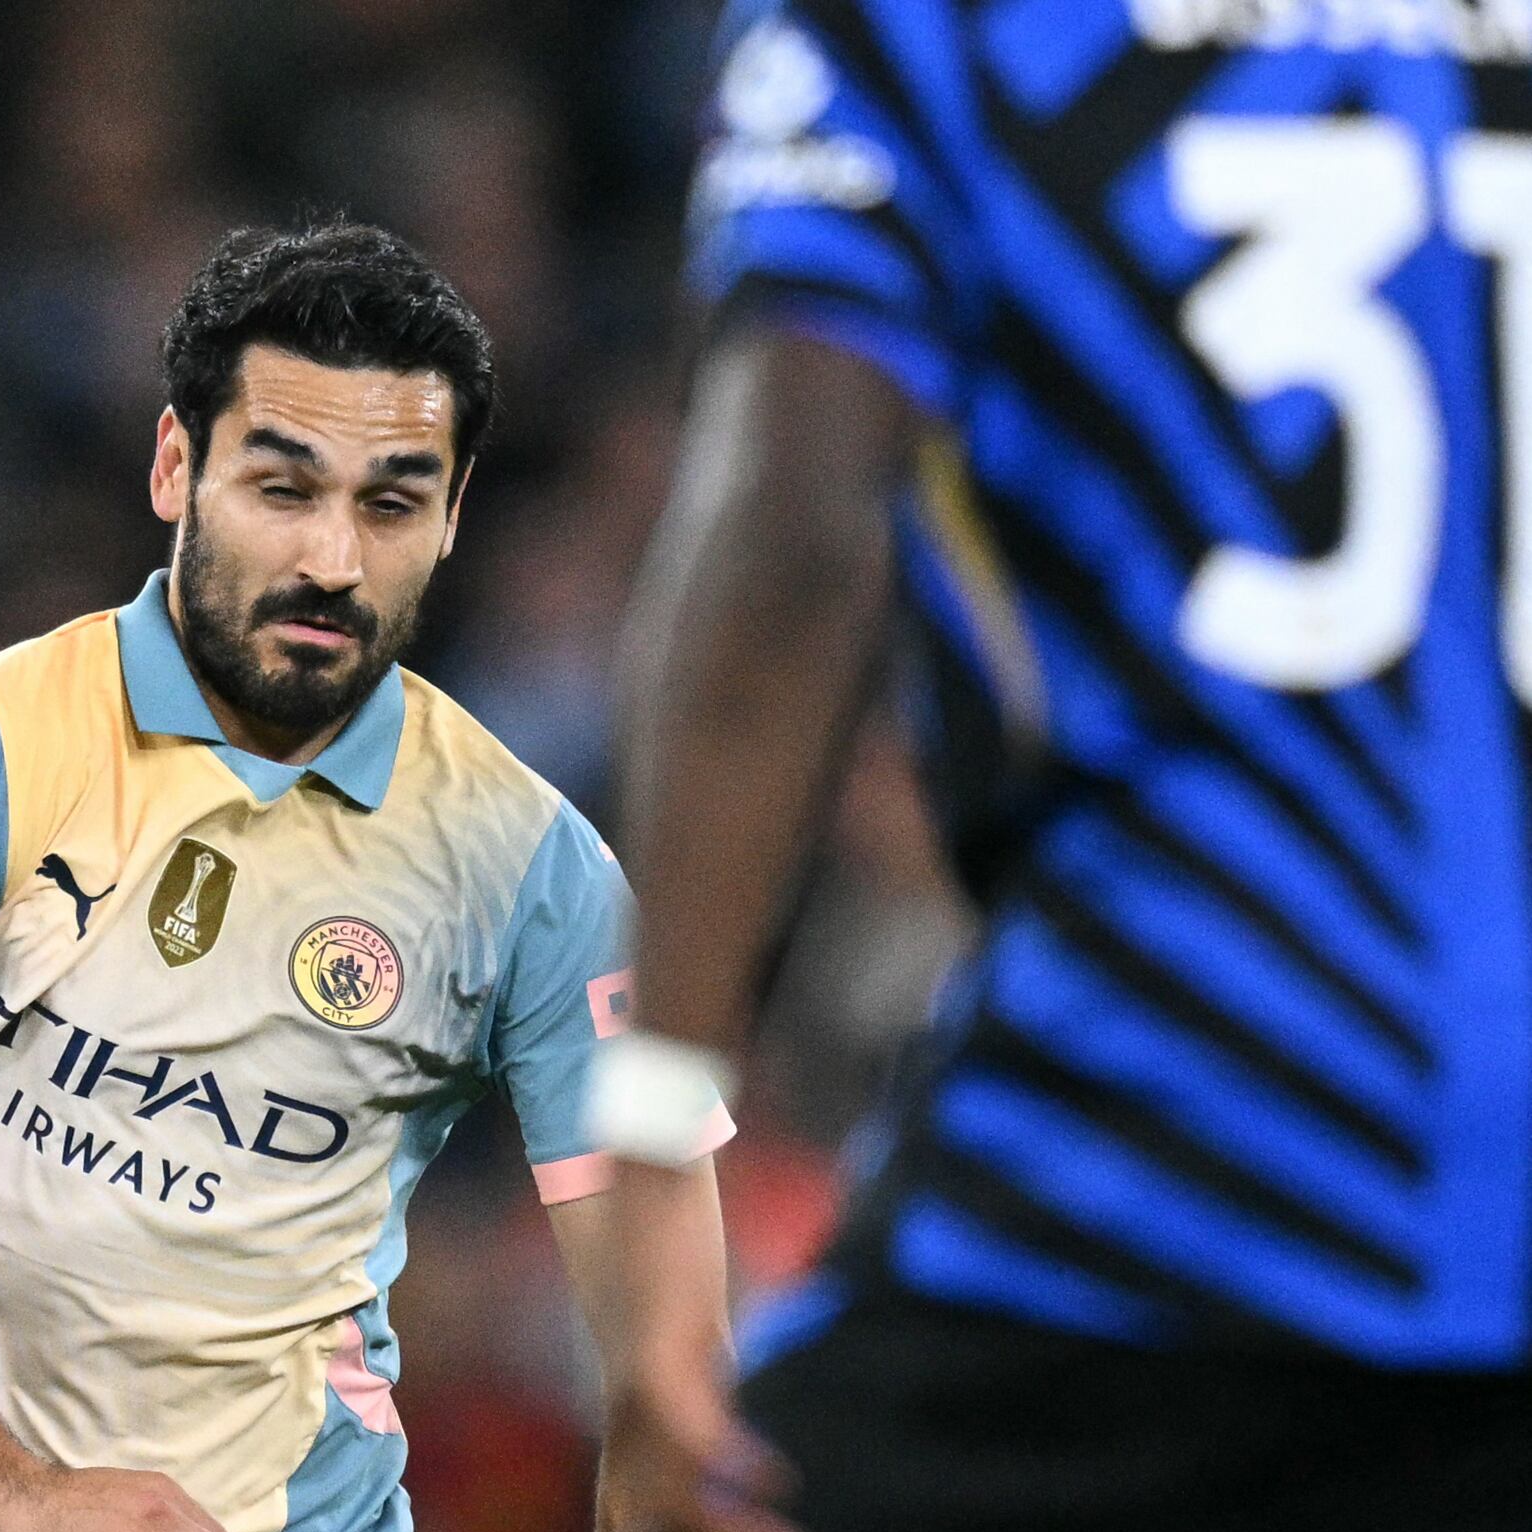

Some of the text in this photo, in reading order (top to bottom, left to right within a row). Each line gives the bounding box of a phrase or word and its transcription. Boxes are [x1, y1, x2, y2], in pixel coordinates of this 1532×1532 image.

[164, 915, 197, 945] FIFA
[308, 925, 394, 974] MANCHESTER
[322, 1006, 354, 1023] CITY
